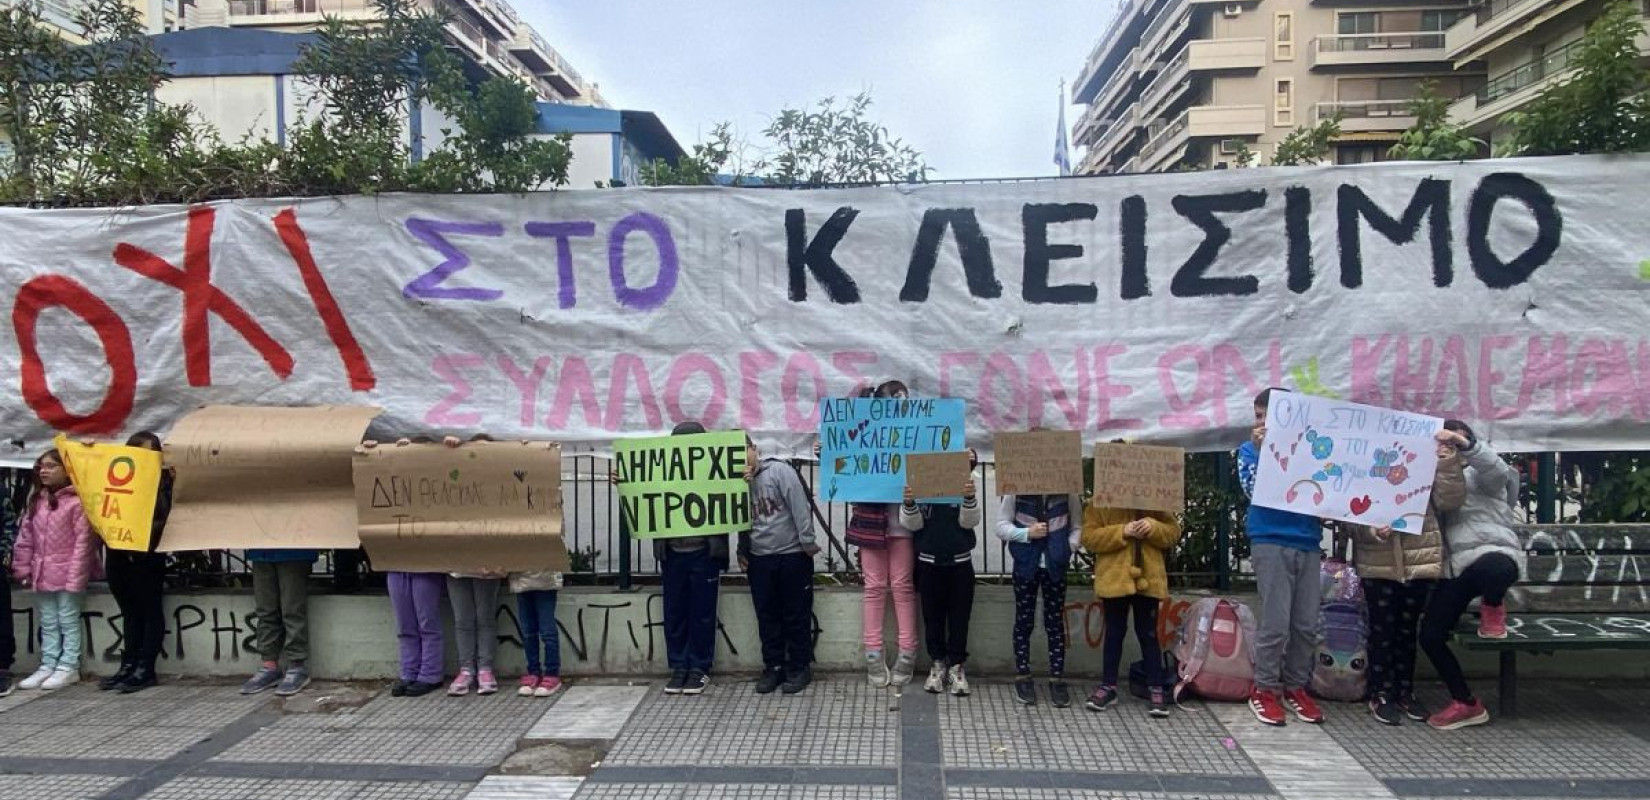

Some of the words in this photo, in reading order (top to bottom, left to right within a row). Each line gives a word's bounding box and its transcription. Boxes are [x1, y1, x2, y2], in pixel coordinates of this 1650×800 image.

[13, 205, 377, 437] ΟΧΙ
[403, 212, 679, 311] ΣΤΟ
[784, 172, 1563, 305] ΚΛΕΙΣΙΜΟ
[823, 398, 856, 423] ΔΕΝ
[869, 398, 936, 421] ΘΕΛΟΥΜΕ
[1322, 407, 1368, 430] ΣΤΟ
[827, 426, 849, 451] ΝΑ
[926, 425, 951, 451] ΤΟ
[616, 446, 745, 483] ΔΗΜΑΡΧΕ
[372, 476, 412, 508] ΔΕΝ
